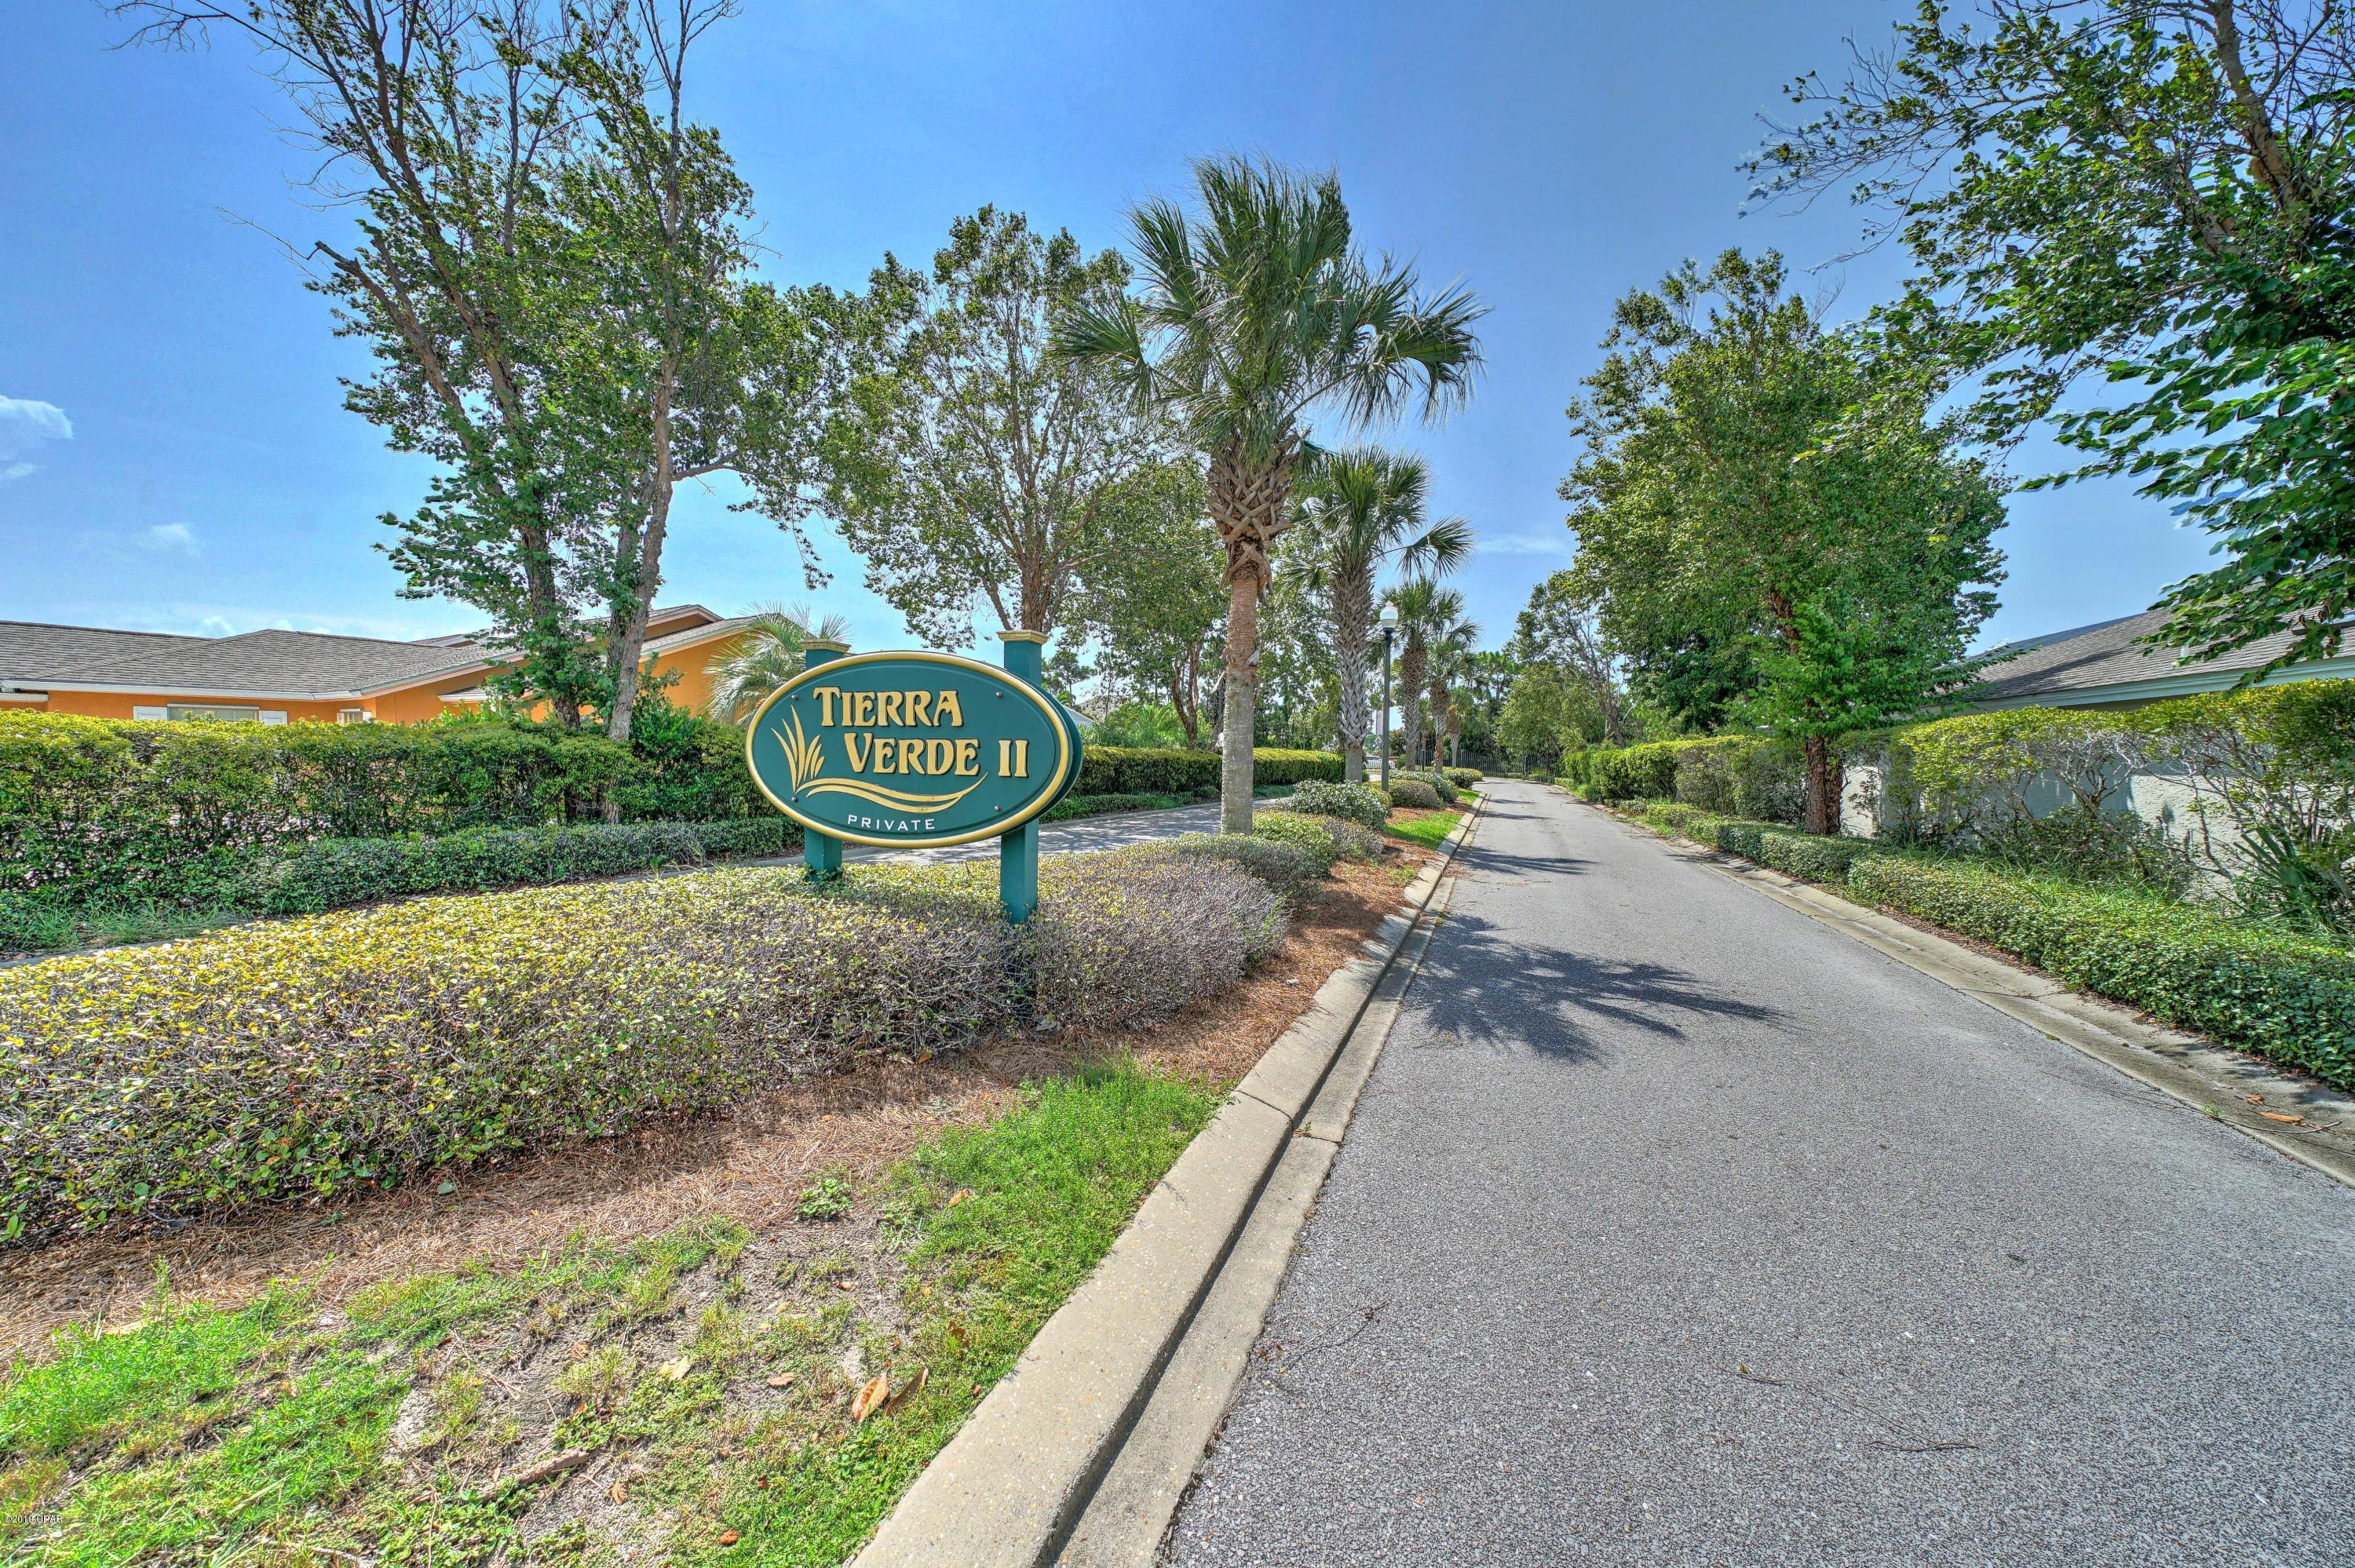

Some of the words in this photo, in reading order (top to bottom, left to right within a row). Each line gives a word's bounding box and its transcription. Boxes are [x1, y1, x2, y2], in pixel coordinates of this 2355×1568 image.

[812, 686, 964, 727] TIERRA
[844, 731, 980, 776] VERDE
[998, 739, 1029, 778] II
[848, 815, 936, 832] PRIVATE
